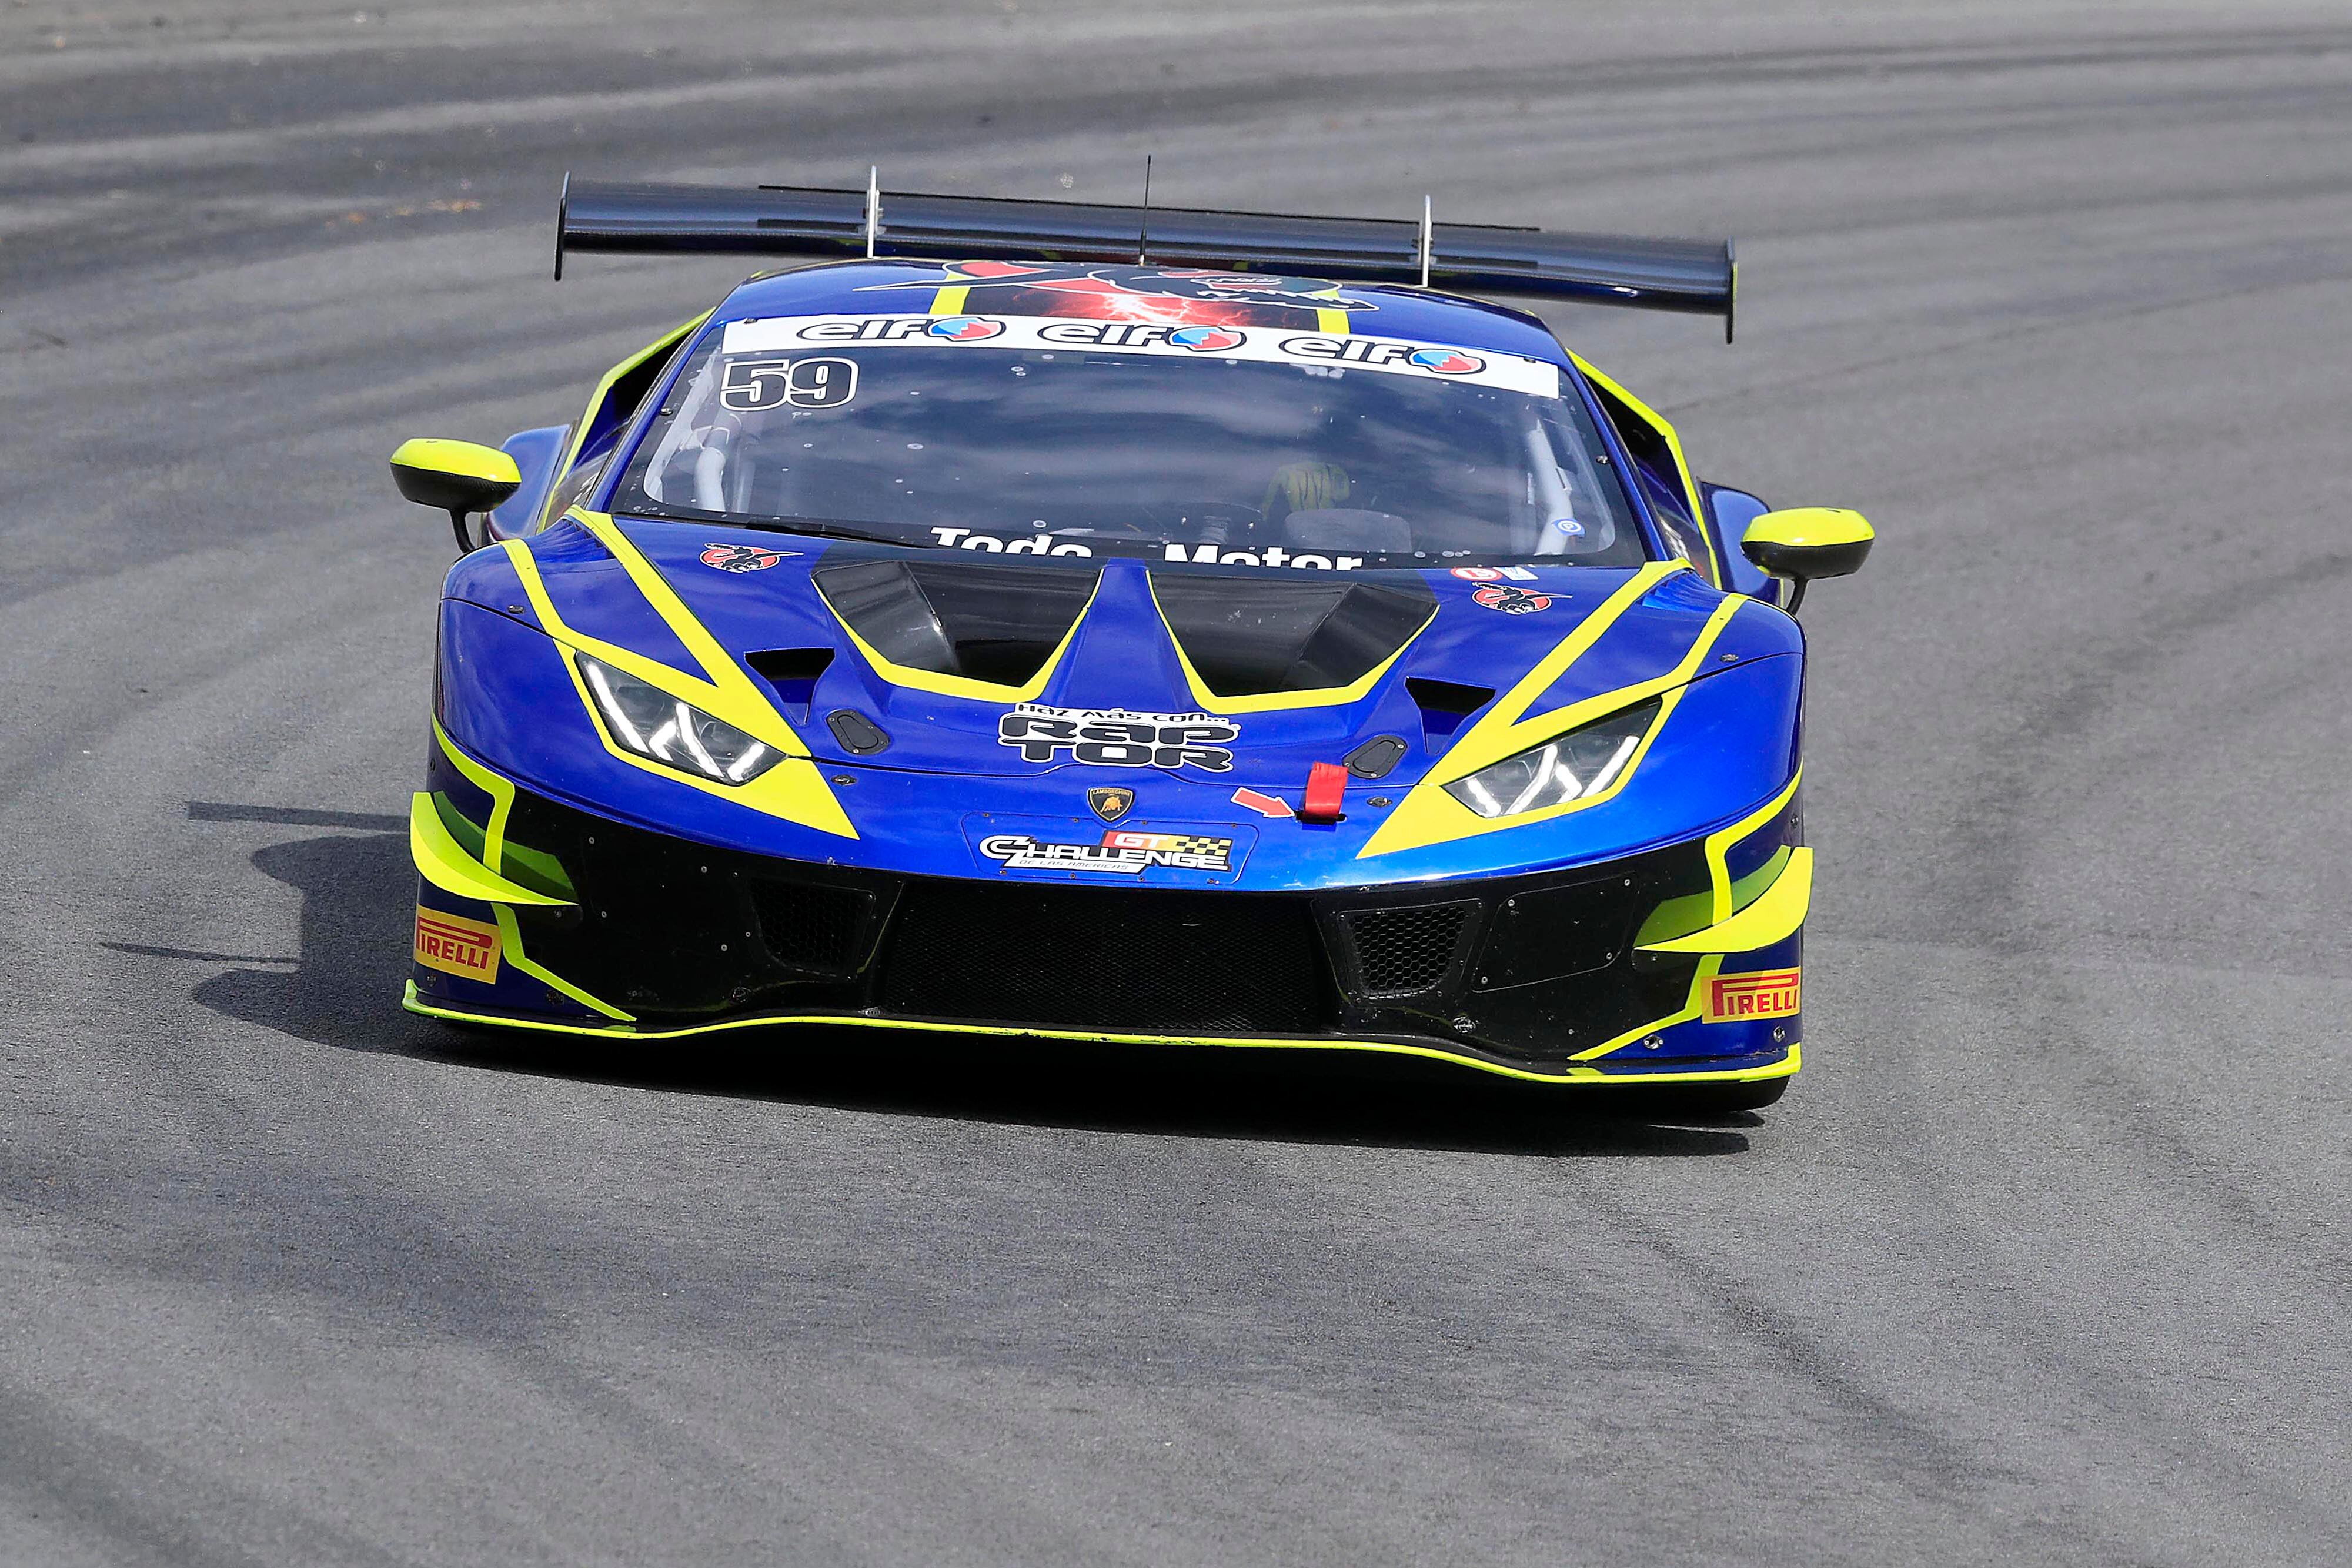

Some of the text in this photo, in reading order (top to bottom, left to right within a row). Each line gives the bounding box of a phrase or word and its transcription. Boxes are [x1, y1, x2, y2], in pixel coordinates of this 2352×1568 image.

[796, 319, 1414, 365] elf elf elf
[720, 357, 859, 411] 59
[1093, 788, 1130, 797] LAMBORGHINI
[1114, 834, 1169, 848] GT
[1712, 973, 1799, 1017] PIRELLI
